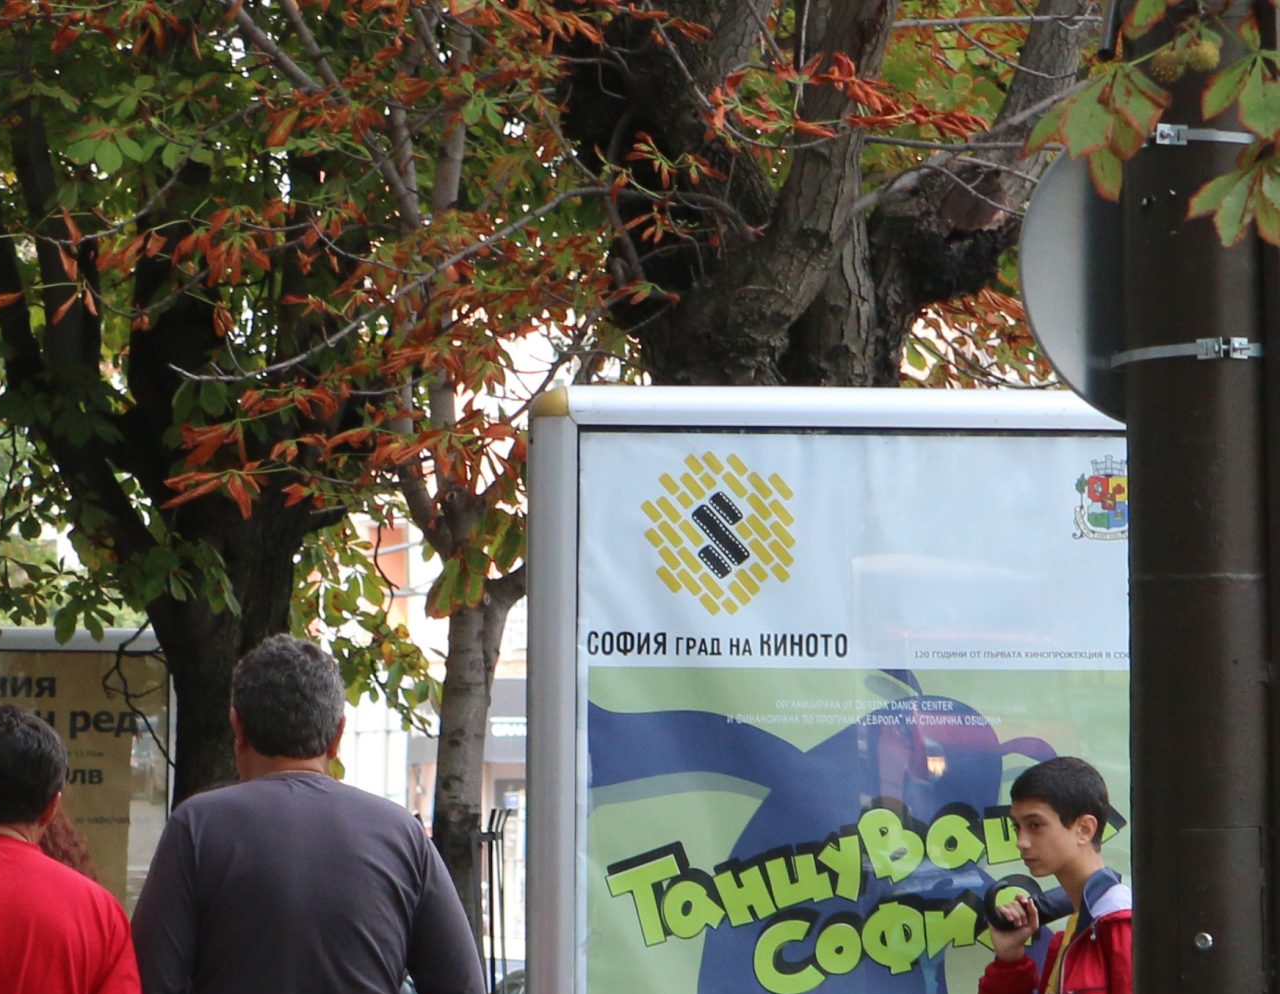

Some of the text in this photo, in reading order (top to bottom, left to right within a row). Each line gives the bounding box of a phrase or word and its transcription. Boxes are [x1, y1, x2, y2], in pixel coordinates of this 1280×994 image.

[587, 630, 848, 657] СОФИЯ ГРАД НА КИНОТО
[914, 650, 930, 659] 120
[932, 650, 967, 660] ГОДИНИ
[969, 650, 980, 659] ОТ
[983, 650, 1022, 660] ПЪРВАТА
[891, 700, 919, 711] DANCE
[921, 701, 954, 711] CENTER
[70, 708, 141, 738] ред
[905, 715, 917, 725] НА
[920, 715, 962, 725] СТОЛИЧНА
[65, 768, 104, 785] лв
